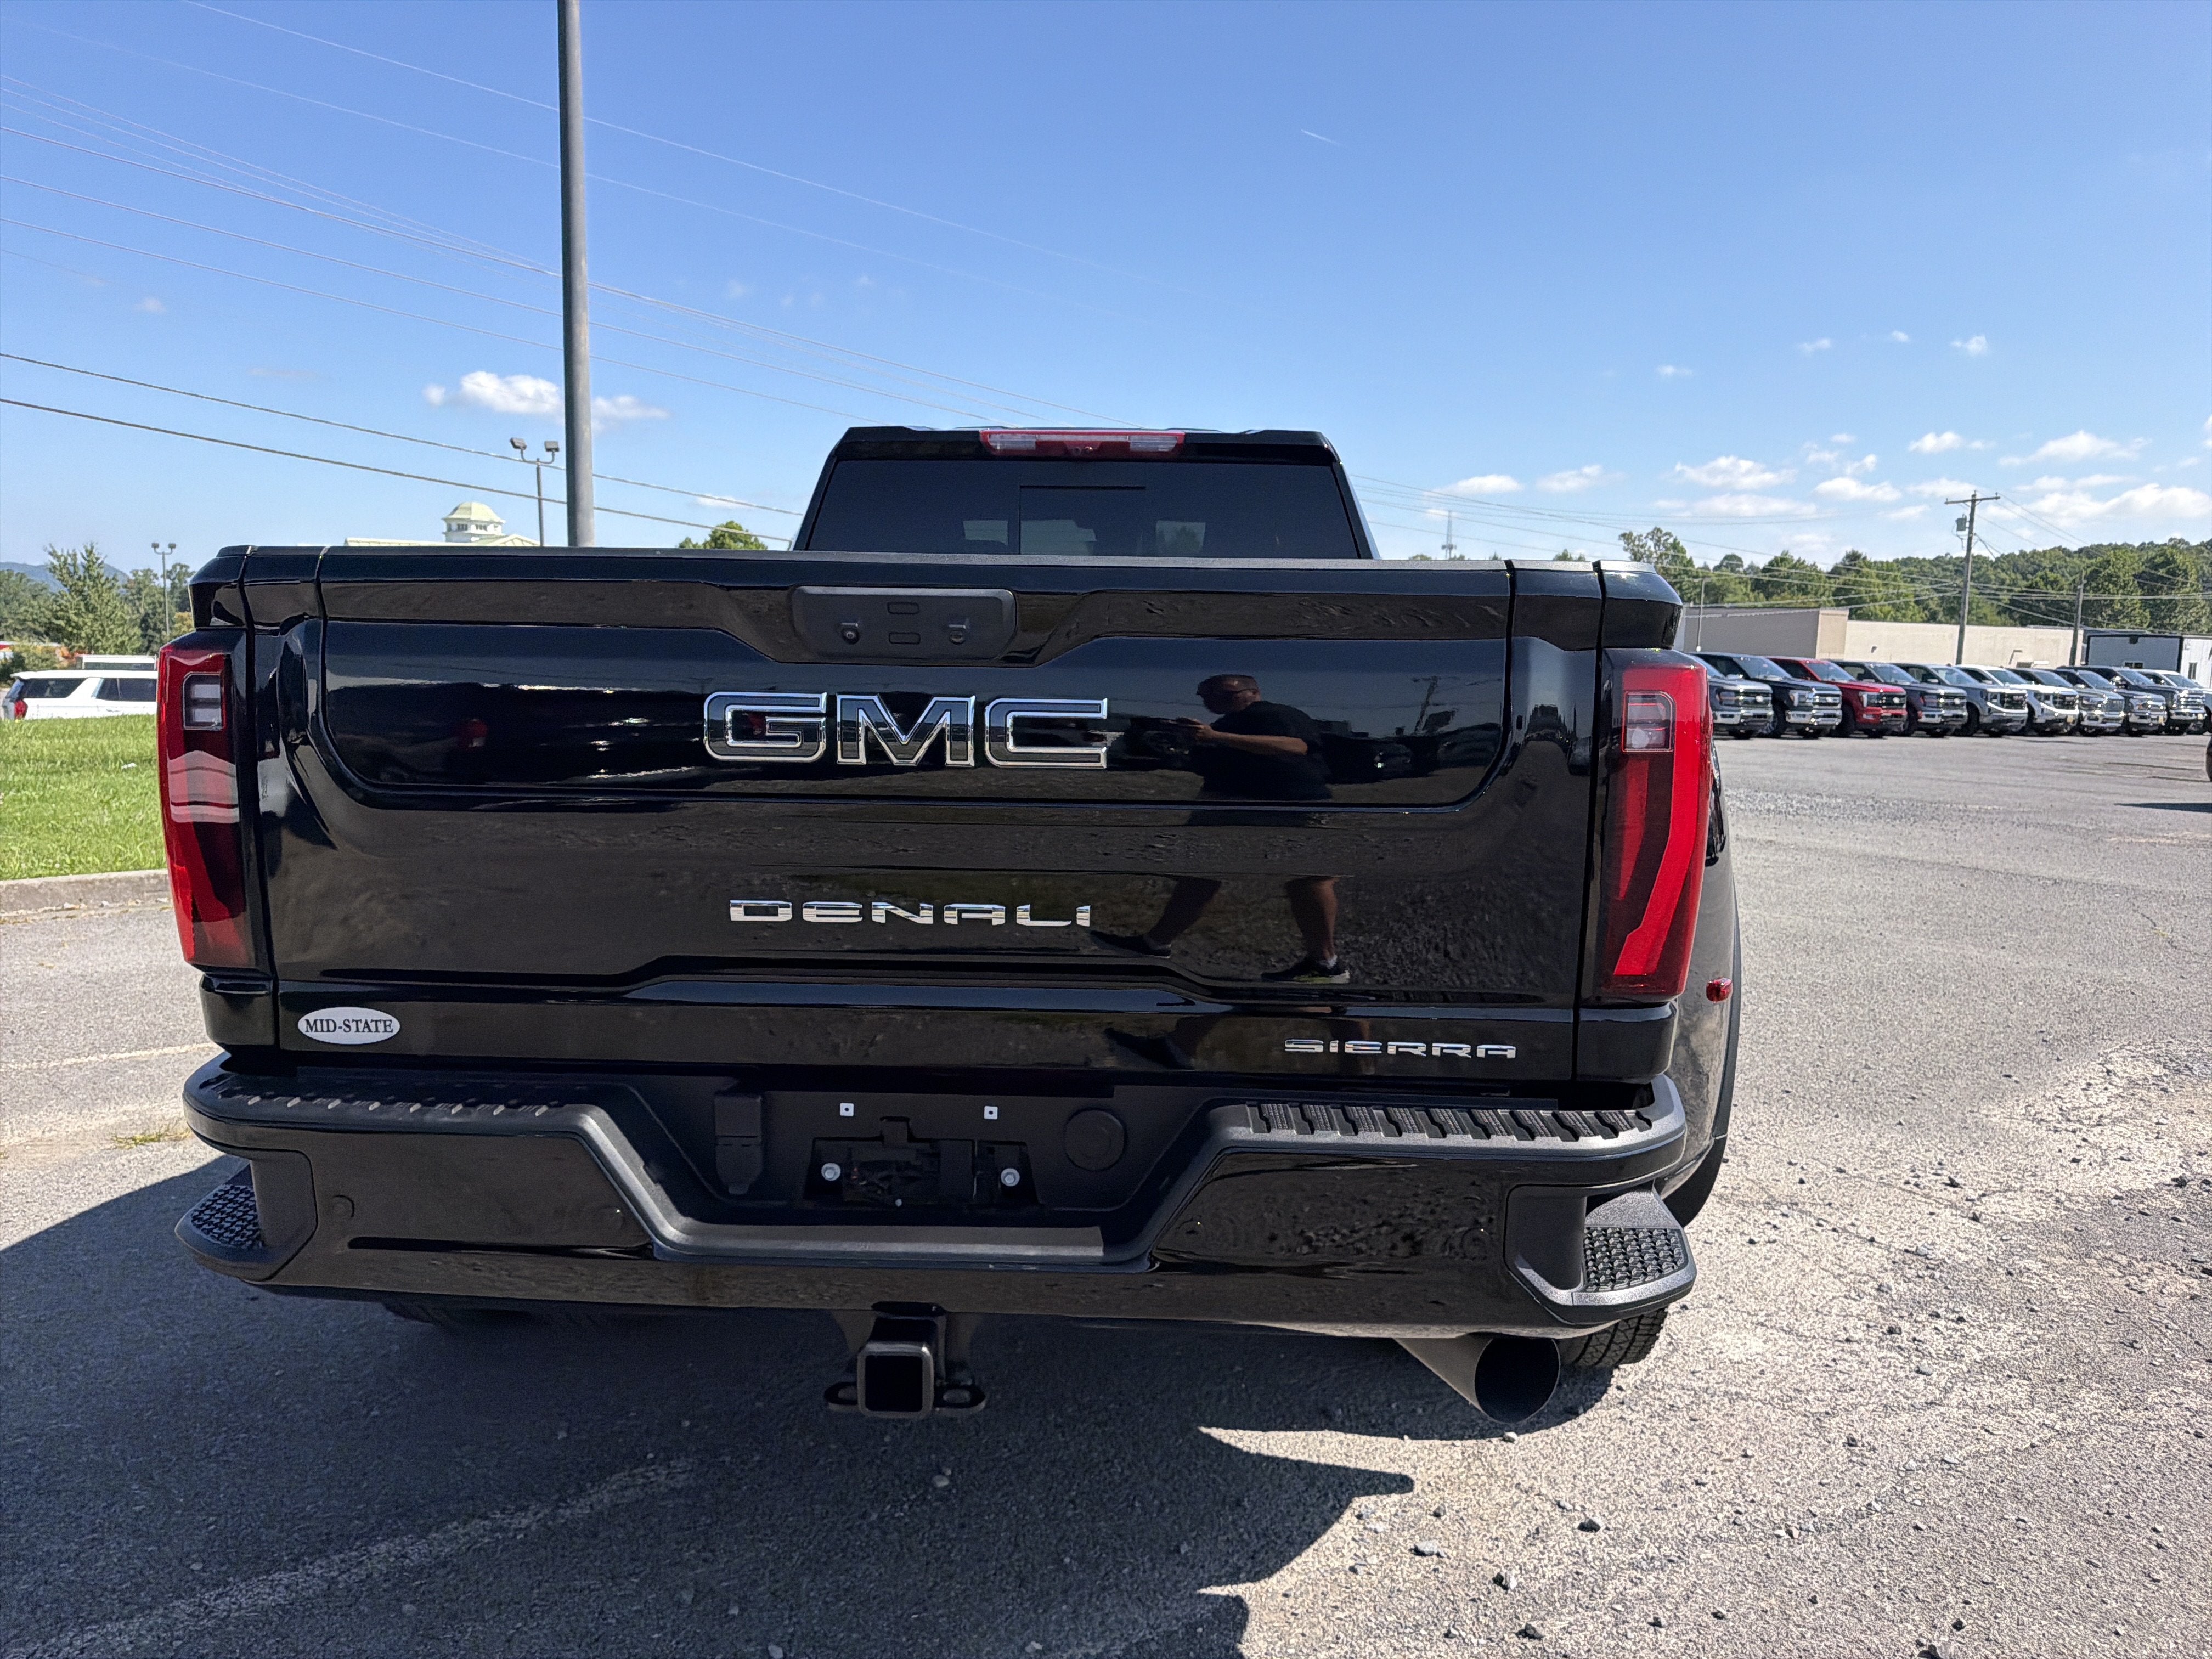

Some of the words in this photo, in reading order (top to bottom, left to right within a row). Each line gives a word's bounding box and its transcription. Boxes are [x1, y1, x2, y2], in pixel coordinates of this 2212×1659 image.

[703, 691, 1108, 768] GMC
[730, 900, 1091, 926] DENALI
[304, 1019, 393, 1033] MID-STATE
[1285, 1039, 1516, 1058] SIERRA
